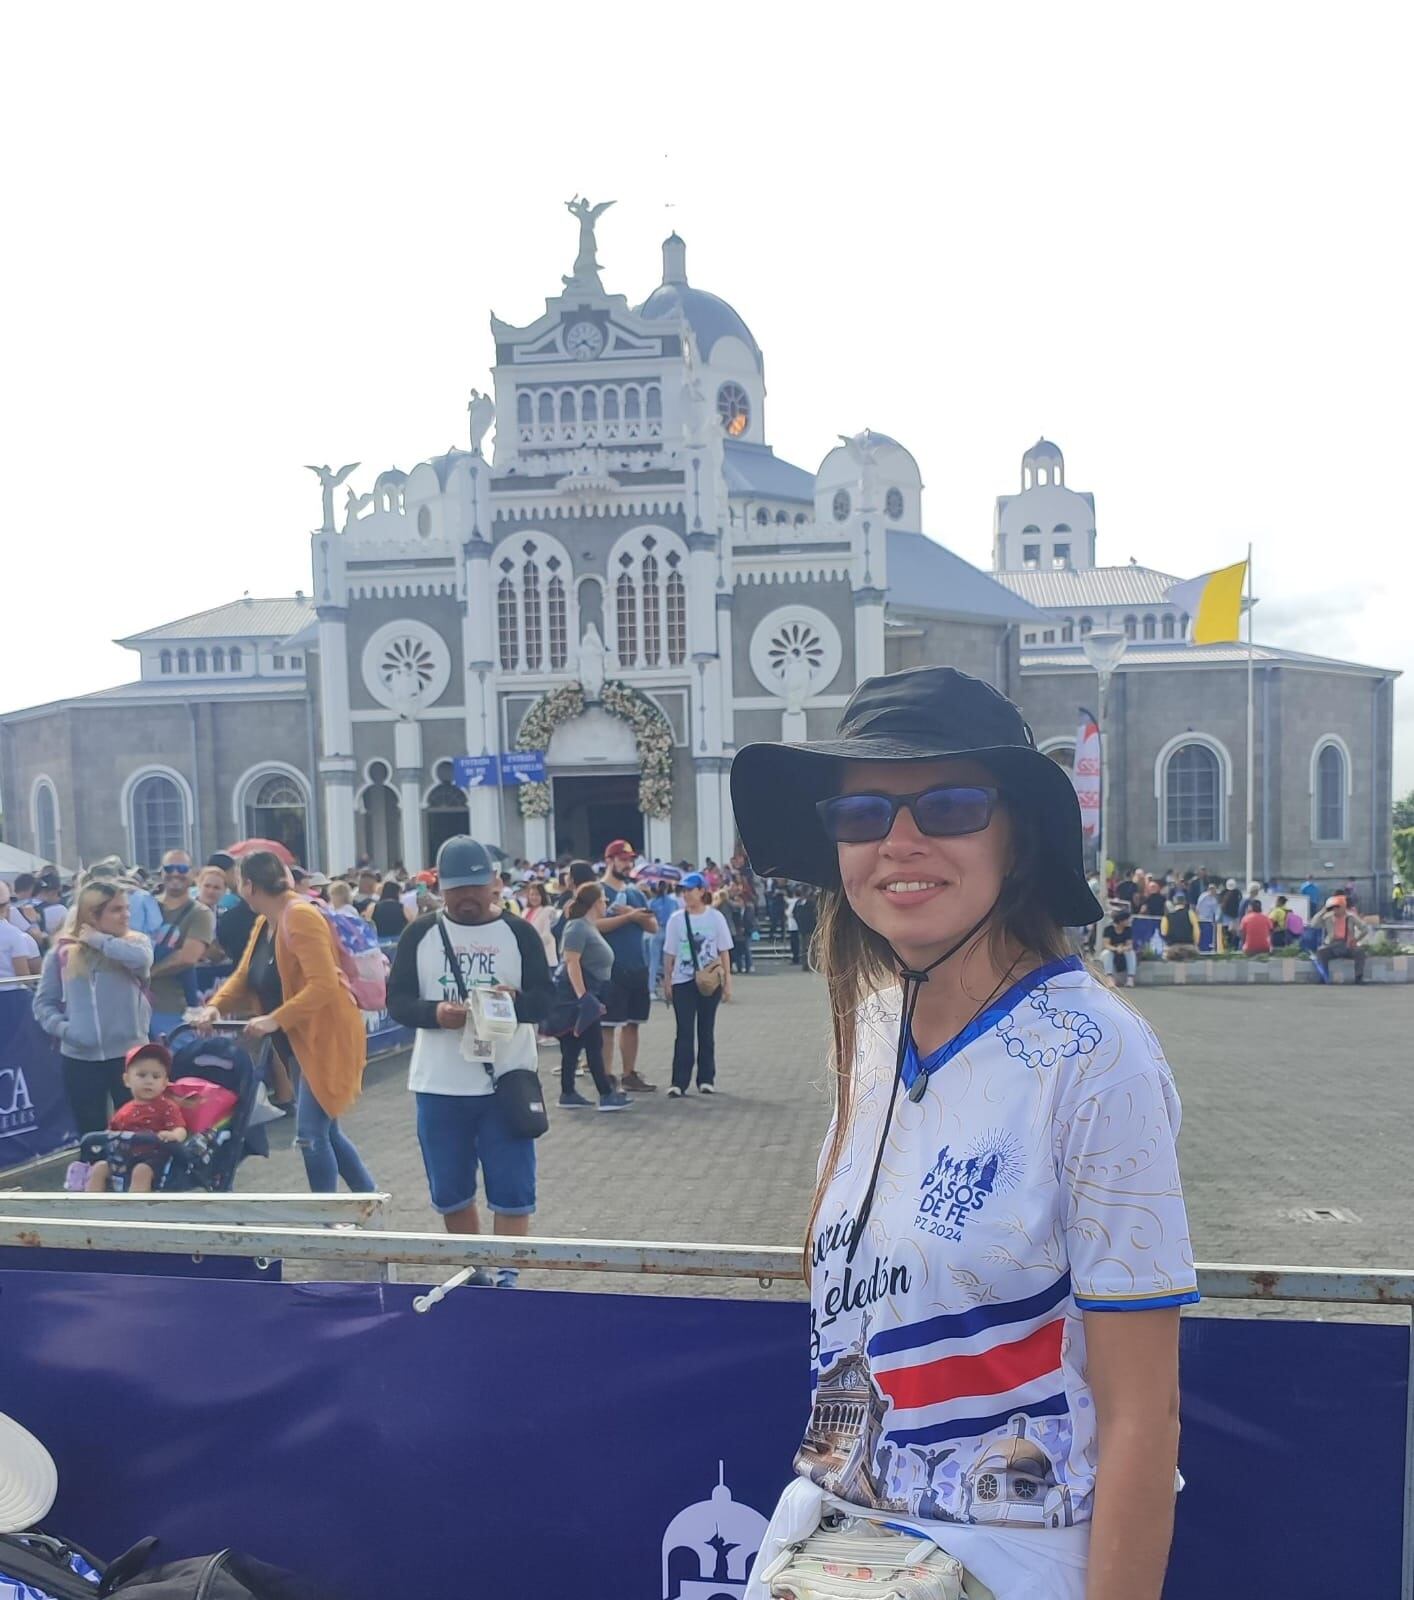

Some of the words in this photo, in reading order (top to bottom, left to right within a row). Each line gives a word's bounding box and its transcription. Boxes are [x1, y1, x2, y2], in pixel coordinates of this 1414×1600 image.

[441, 949, 496, 977] TEY'RE
[919, 1172, 987, 1211] PASOS
[919, 1193, 946, 1218] DE
[944, 1202, 971, 1228] FE
[913, 1215, 929, 1231] PZ
[928, 1221, 962, 1243] 2024
[821, 1255, 912, 1328] eledón
